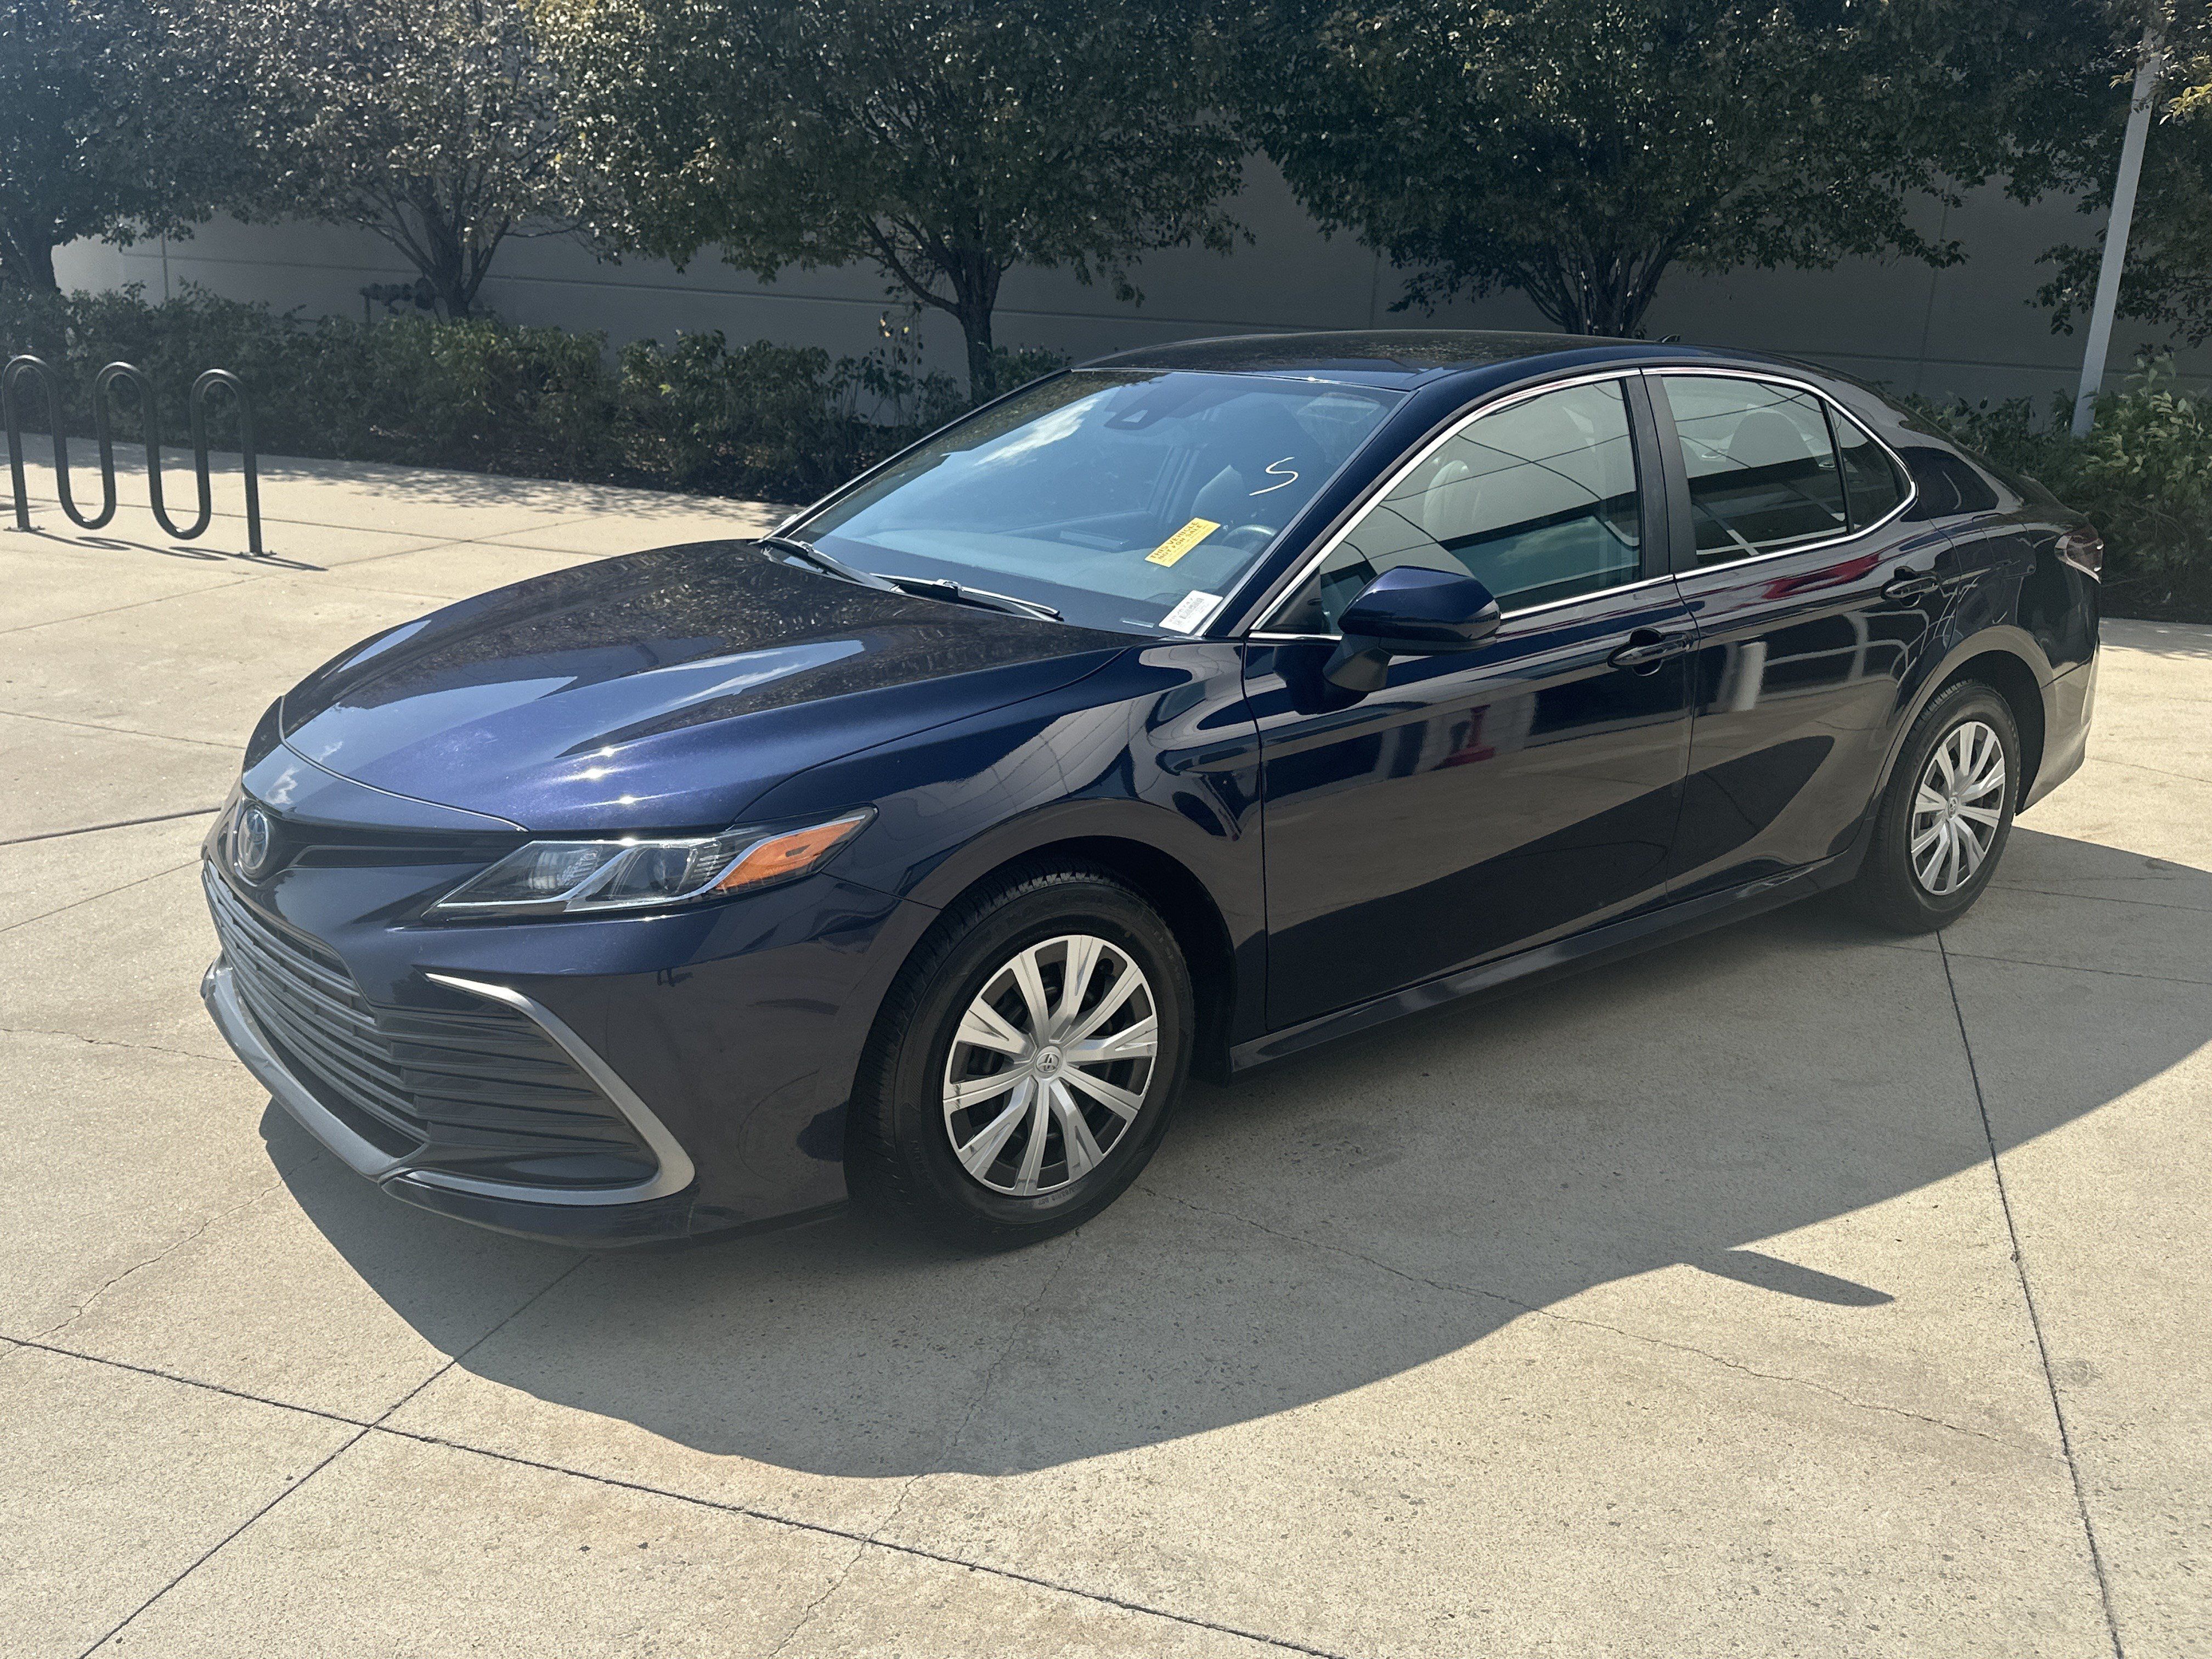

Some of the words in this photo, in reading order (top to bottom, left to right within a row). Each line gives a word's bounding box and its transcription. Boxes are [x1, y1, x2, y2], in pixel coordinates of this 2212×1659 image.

[1249, 456, 1299, 496] S
[1150, 545, 1169, 558] THIS
[1167, 522, 1199, 545] VEHICLE
[1158, 549, 1172, 560] NOT
[1171, 538, 1186, 549] FOR
[1185, 524, 1202, 537] SALE
